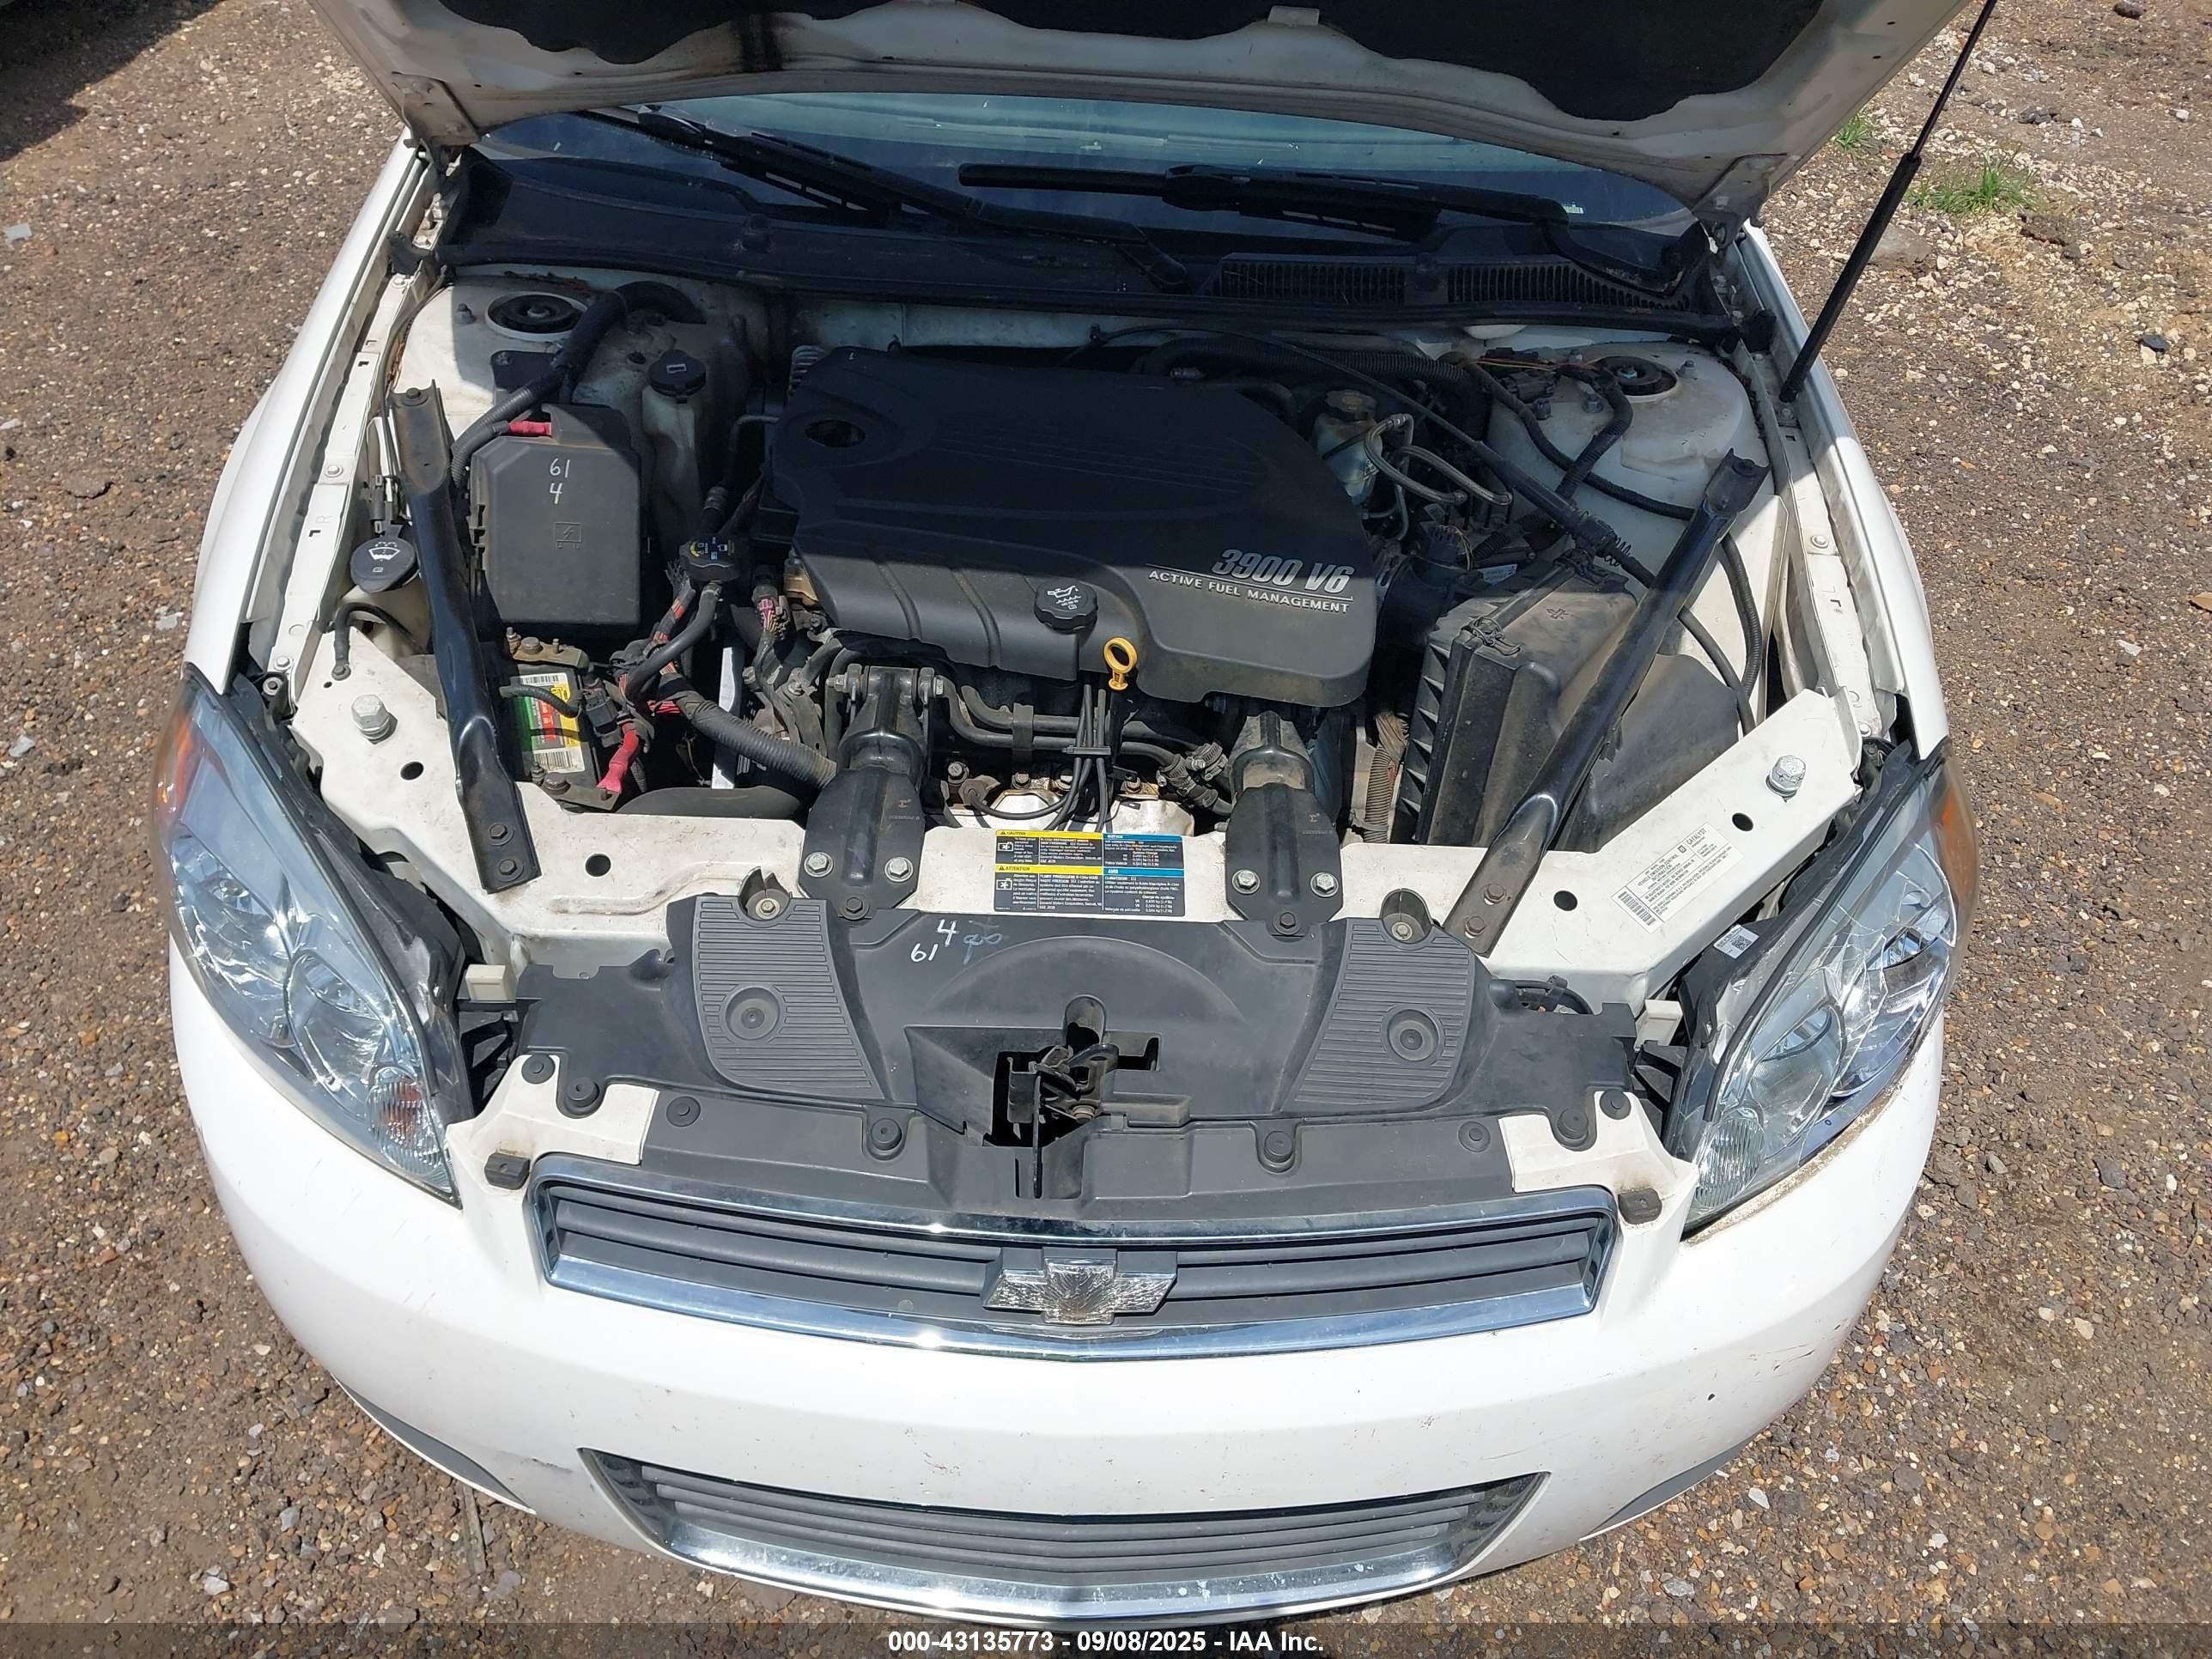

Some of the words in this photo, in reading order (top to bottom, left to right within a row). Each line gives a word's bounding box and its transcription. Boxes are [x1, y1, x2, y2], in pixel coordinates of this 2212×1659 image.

[549, 458, 571, 478] 61
[549, 482, 563, 505] 4
[1211, 548, 1303, 589] 3900
[1304, 562, 1356, 594] V6
[1147, 568, 1203, 590] ACTIVE
[1207, 580, 1241, 598] FUEL
[1246, 588, 1351, 615] MANAGEMENT
[936, 919, 958, 948] 4
[910, 943, 939, 963] 61
